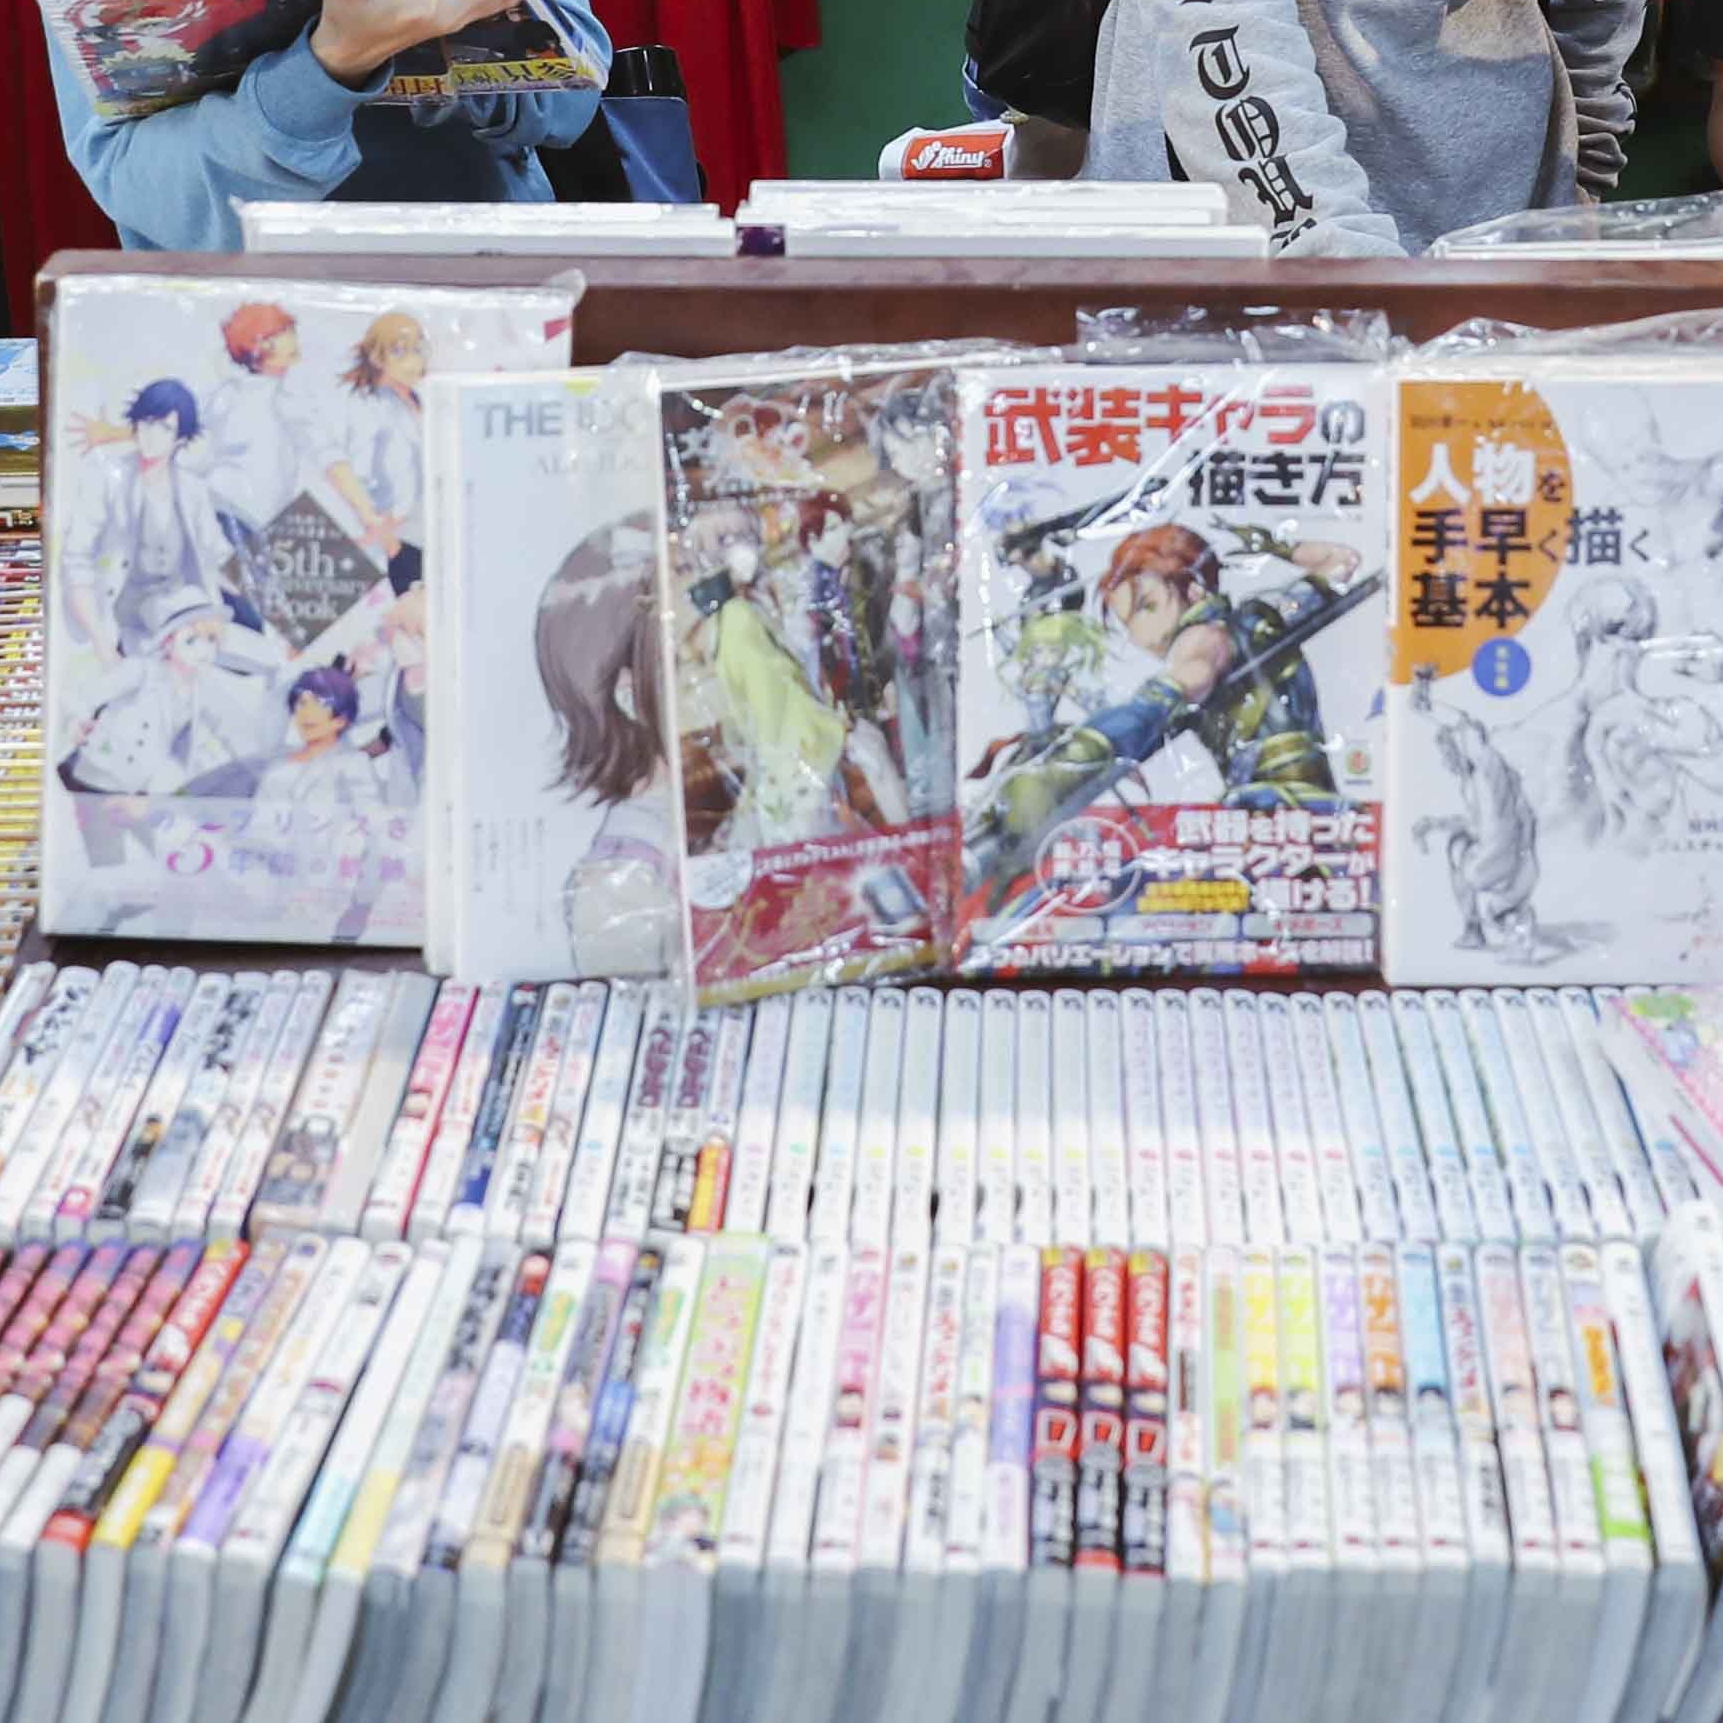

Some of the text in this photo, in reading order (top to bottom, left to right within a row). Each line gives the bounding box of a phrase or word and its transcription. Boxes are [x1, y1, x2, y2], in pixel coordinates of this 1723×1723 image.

[479, 401, 567, 439] THE
[1186, 449, 1366, 508] 描き方
[1409, 444, 1567, 503] 人物を
[1409, 507, 1652, 568] 手早く描く
[1409, 571, 1532, 630] 基本
